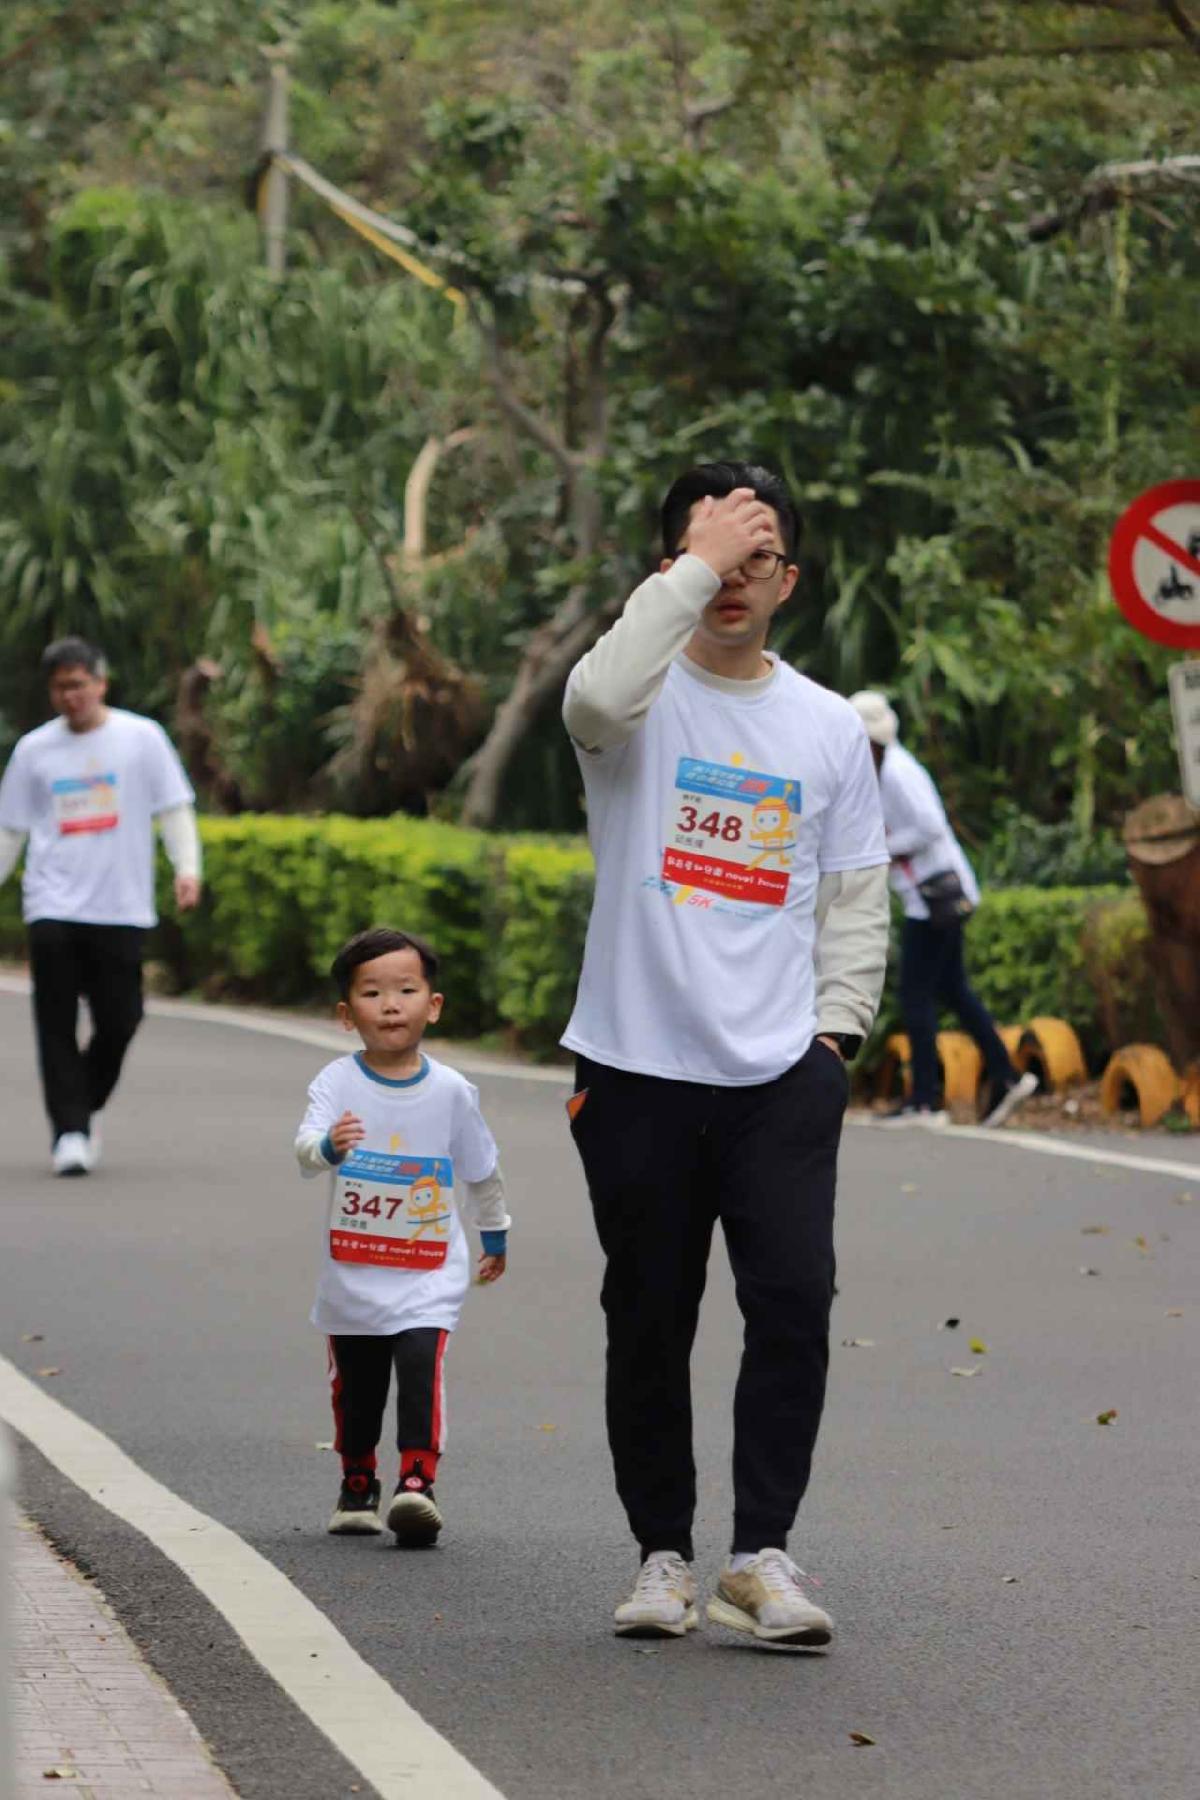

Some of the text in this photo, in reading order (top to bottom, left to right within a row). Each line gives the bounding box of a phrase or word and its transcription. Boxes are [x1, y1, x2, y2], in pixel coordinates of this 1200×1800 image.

[676, 806, 743, 842] 348
[725, 871, 755, 884] novel
[341, 1191, 404, 1220] 347
[389, 1247, 416, 1256] novel
